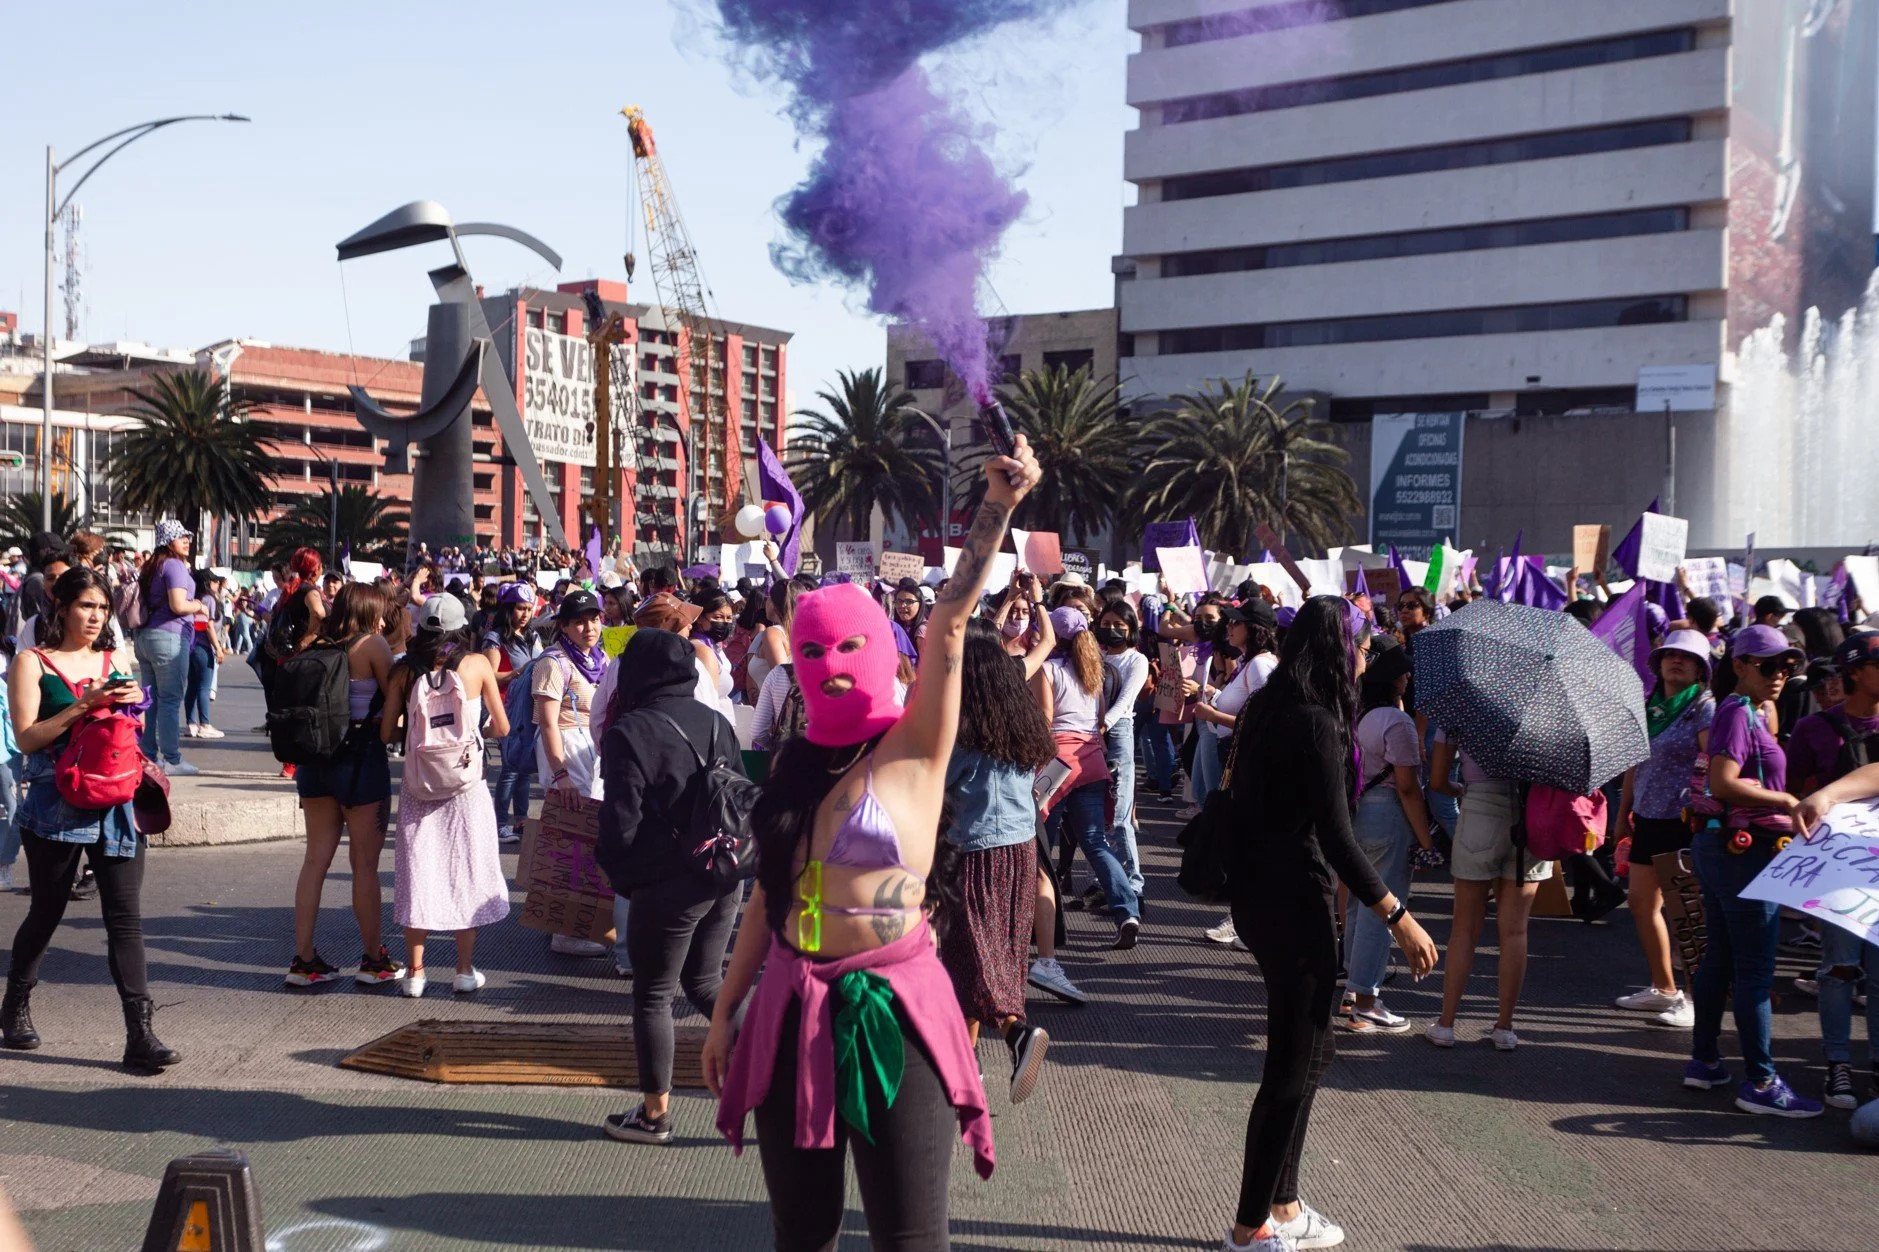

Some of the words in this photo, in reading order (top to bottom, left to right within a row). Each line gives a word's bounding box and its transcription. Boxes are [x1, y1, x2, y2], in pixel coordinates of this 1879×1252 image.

[527, 331, 553, 374] SE
[526, 419, 569, 444] TRATO
[1418, 432, 1447, 446] OFICINAS
[1395, 474, 1451, 487] INFORMES
[541, 803, 560, 828] NO
[1769, 855, 1828, 889] ERA
[547, 901, 566, 928] QUE
